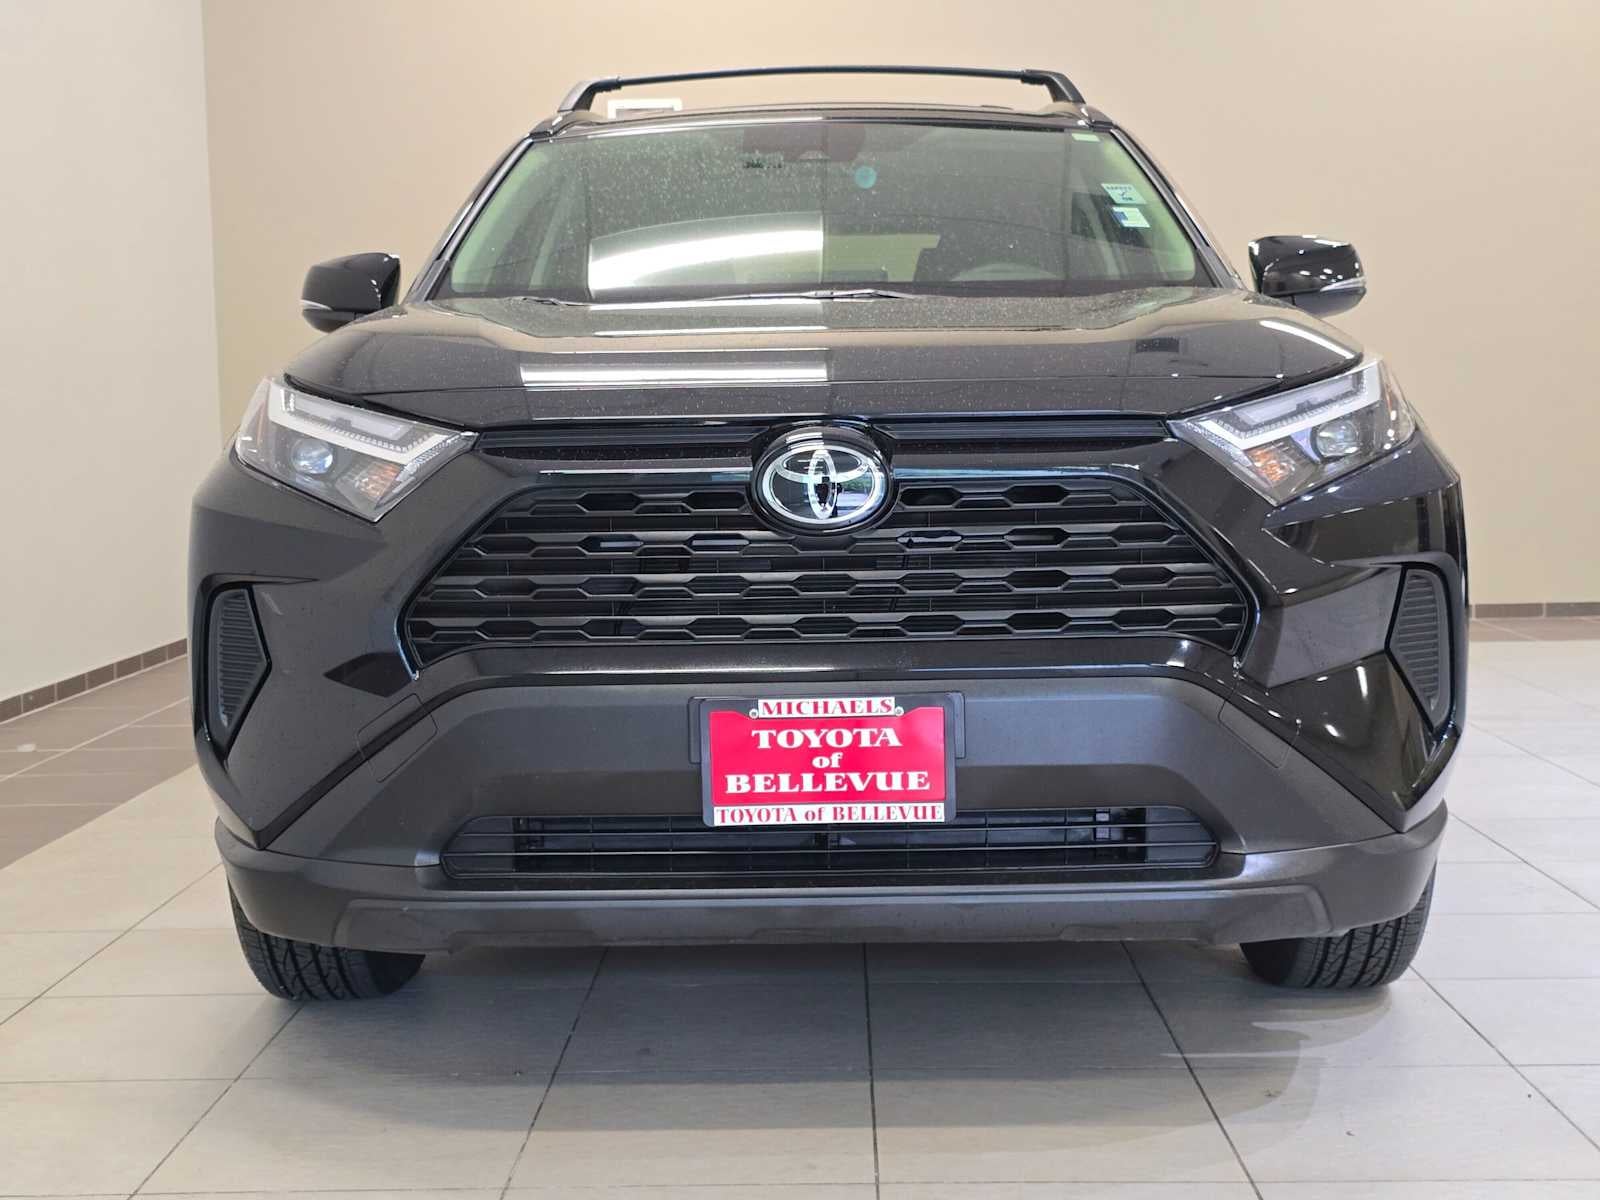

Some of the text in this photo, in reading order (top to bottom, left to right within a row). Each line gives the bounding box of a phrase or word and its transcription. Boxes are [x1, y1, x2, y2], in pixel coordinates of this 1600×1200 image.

[762, 698, 892, 717] MICHAELS
[752, 727, 902, 749] TOYOTA
[812, 751, 843, 769] of
[724, 771, 930, 795] BELLEVUE
[716, 805, 942, 824] TOYOTA of BELLEVUE
